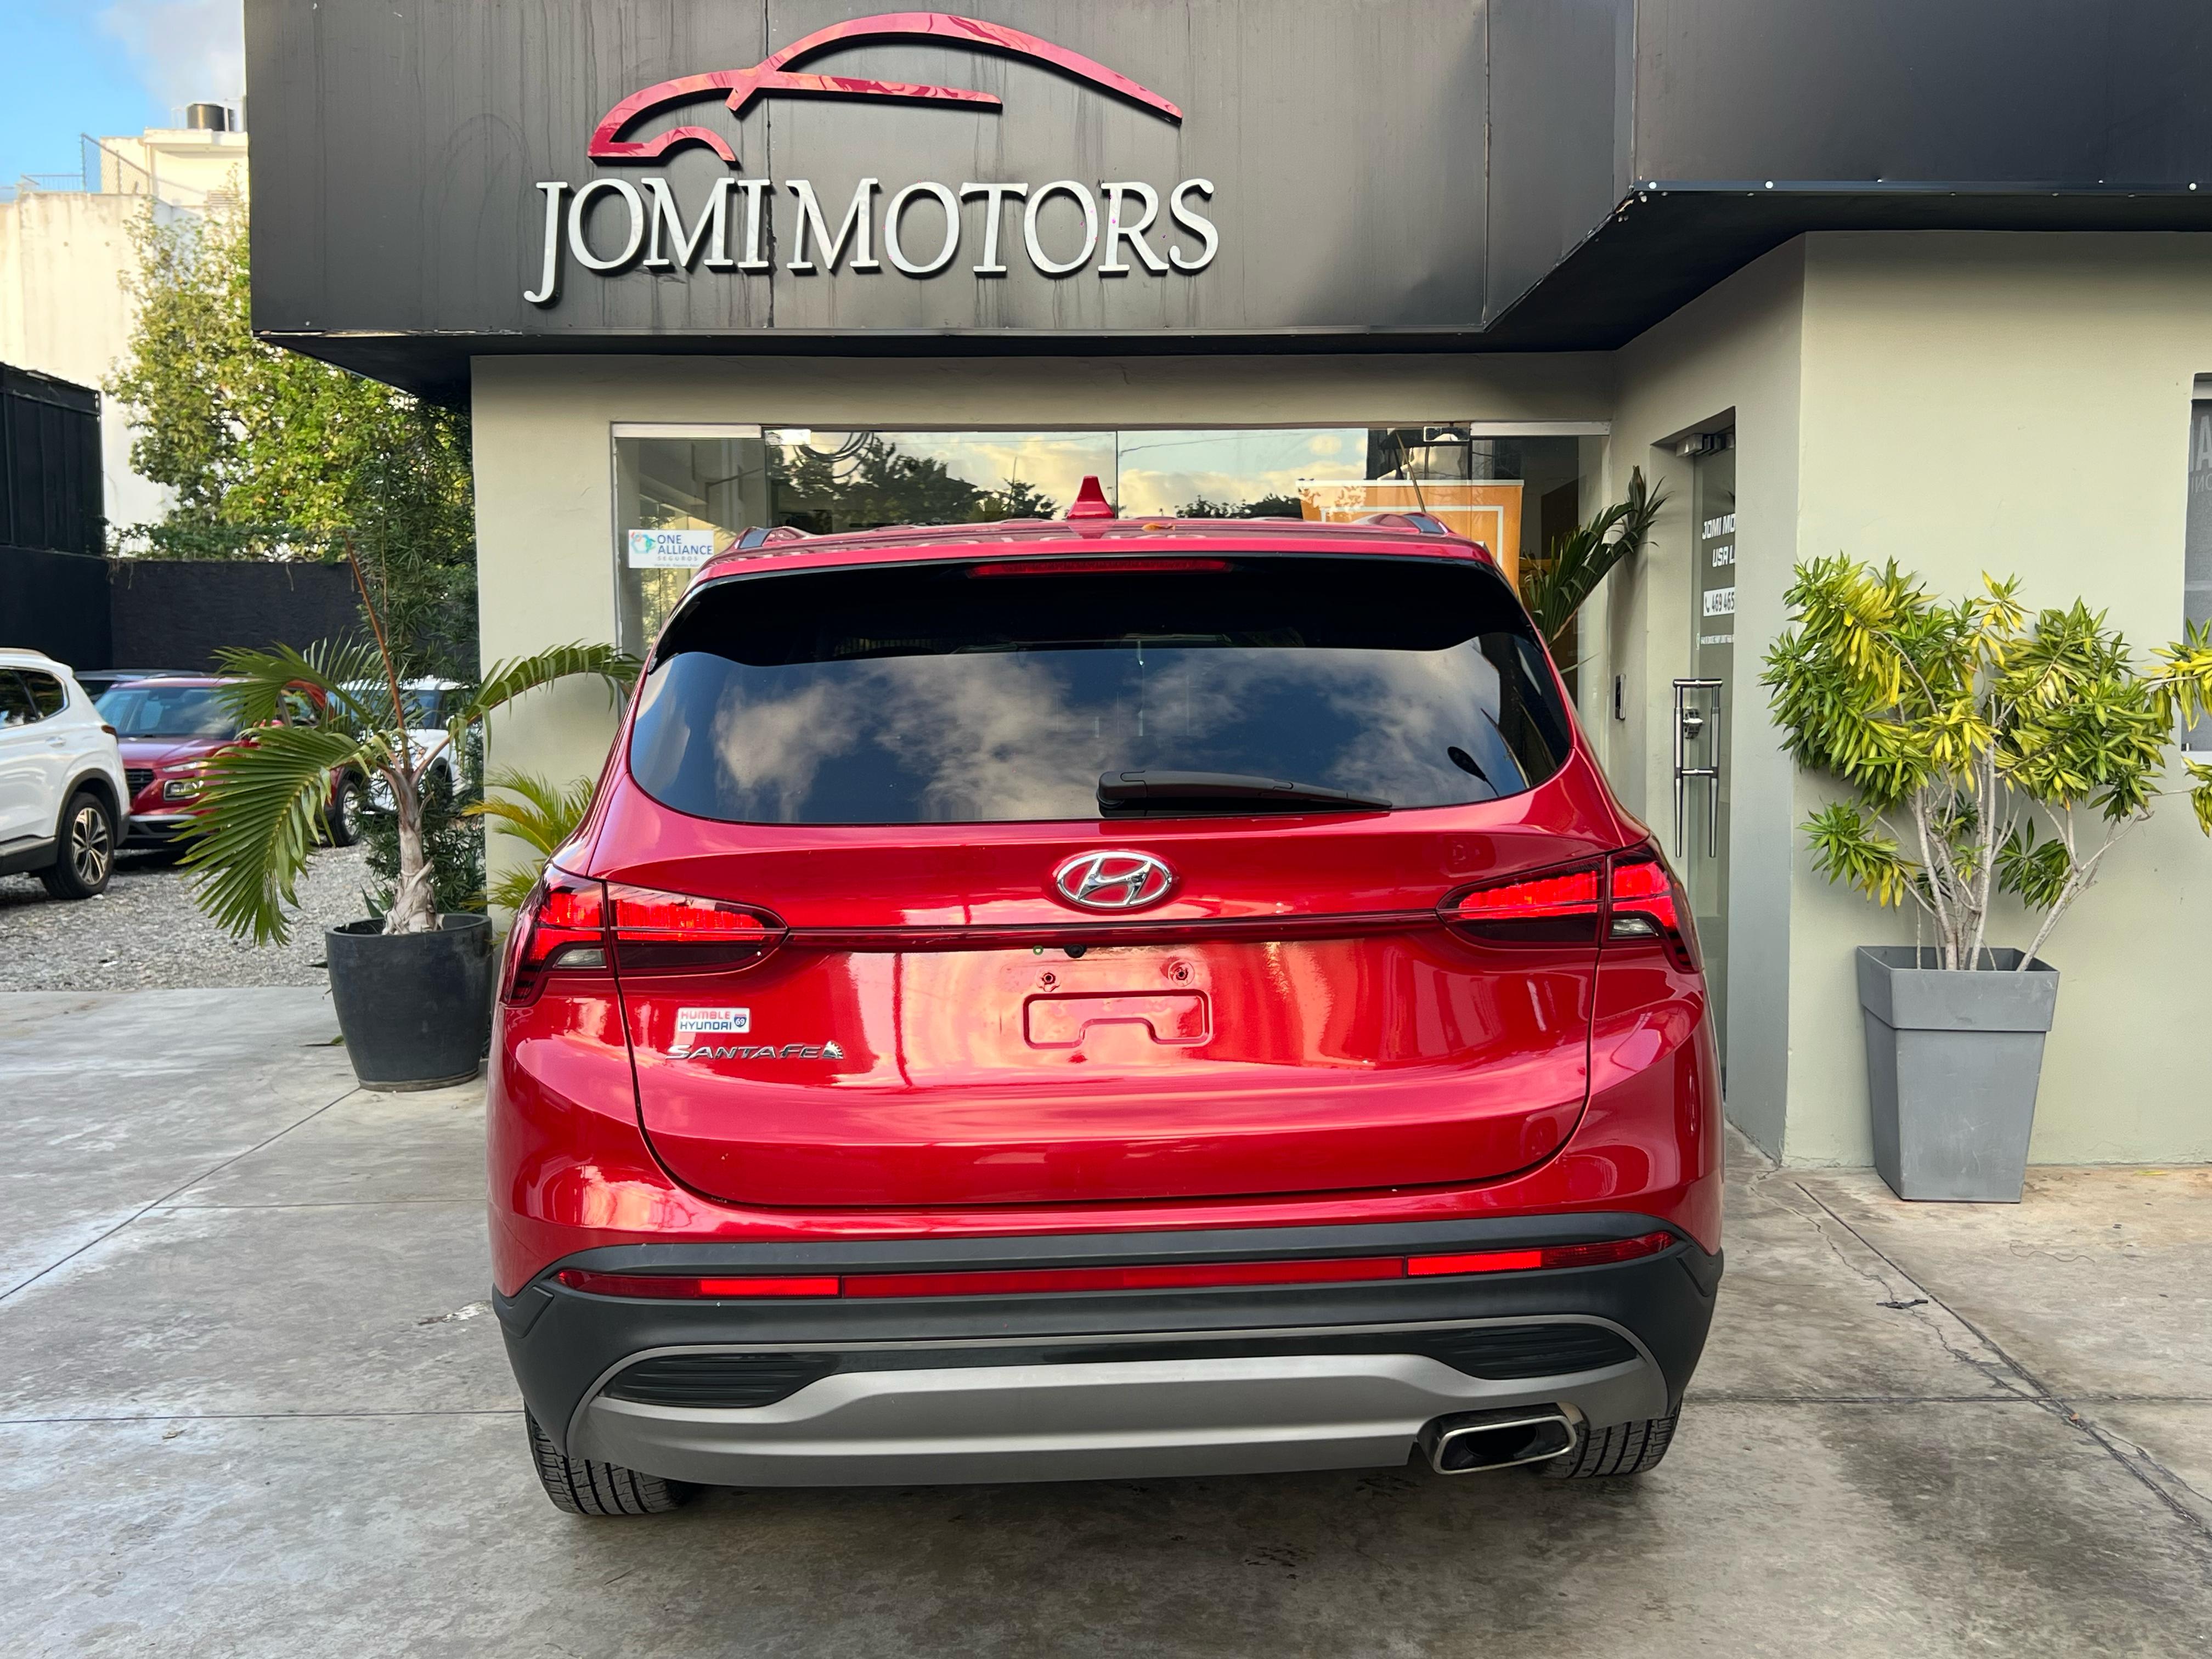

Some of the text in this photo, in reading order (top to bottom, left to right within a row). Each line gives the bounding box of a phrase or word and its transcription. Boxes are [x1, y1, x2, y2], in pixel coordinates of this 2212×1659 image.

[523, 177, 1220, 306] JOMI MOTORS
[1702, 517, 1722, 540] JOMI
[657, 535, 682, 544] ONE
[658, 545, 713, 554] ALLIANCE
[1712, 546, 1729, 567] USA
[1711, 592, 1722, 612] 469
[681, 1011, 731, 1019] HUMBLE
[680, 1018, 746, 1030] HYUNDAI 69
[665, 1044, 777, 1059] SANTA
